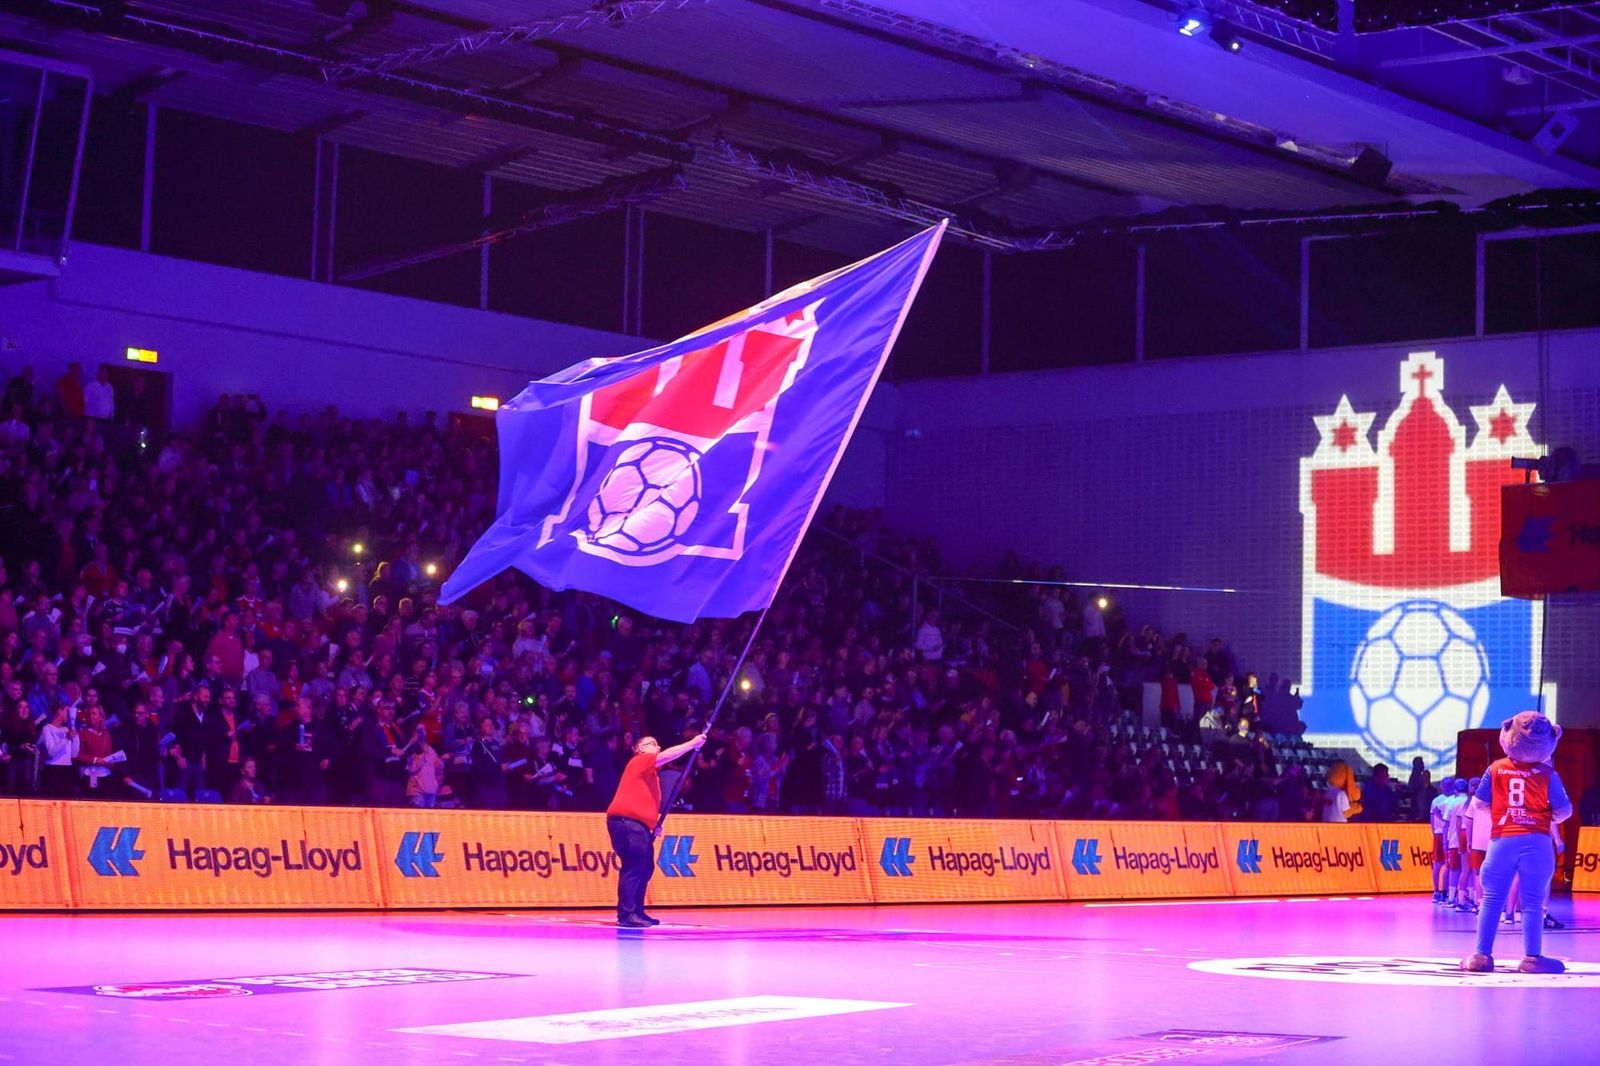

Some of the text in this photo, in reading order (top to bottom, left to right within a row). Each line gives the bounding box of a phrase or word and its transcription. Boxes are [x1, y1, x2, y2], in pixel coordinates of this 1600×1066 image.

[1509, 778, 1525, 806] 8
[167, 838, 361, 878] Hapag-Lloyd
[714, 844, 857, 877] Hapag-Lloyd
[928, 846, 1051, 876] Hapag-Lloyd
[1113, 846, 1219, 875] Hapag-Lloyd
[1272, 846, 1364, 872] Hapag-Lloyd
